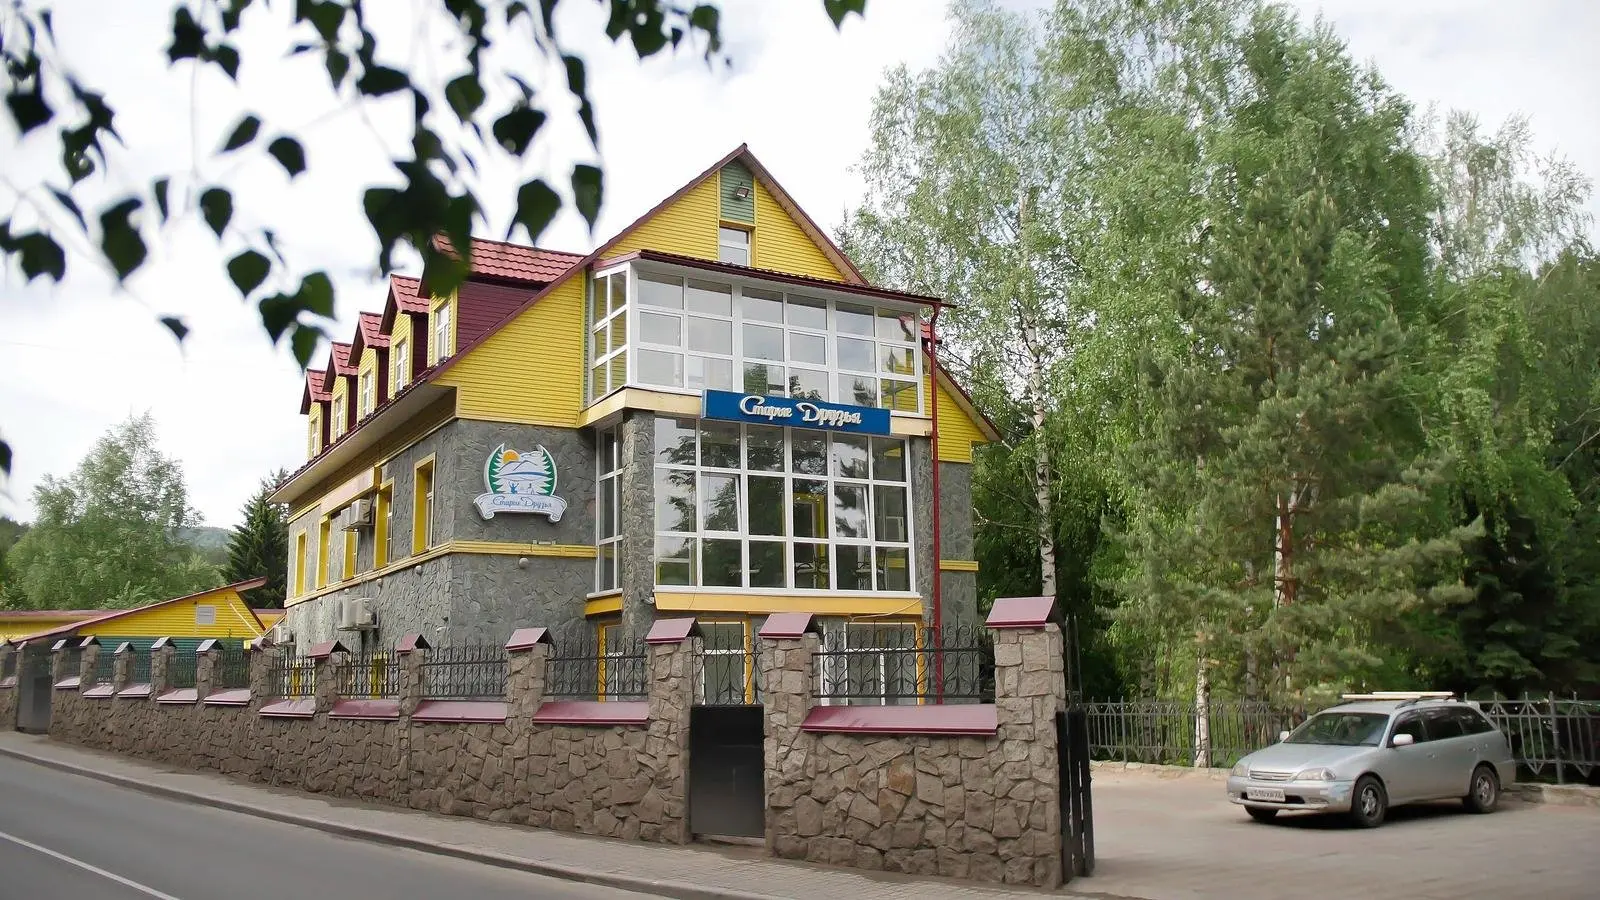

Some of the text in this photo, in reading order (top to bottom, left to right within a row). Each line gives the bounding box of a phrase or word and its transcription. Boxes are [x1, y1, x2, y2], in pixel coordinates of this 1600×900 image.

[739, 395, 862, 427] Старые Друзья
[520, 497, 552, 509] Друзья
